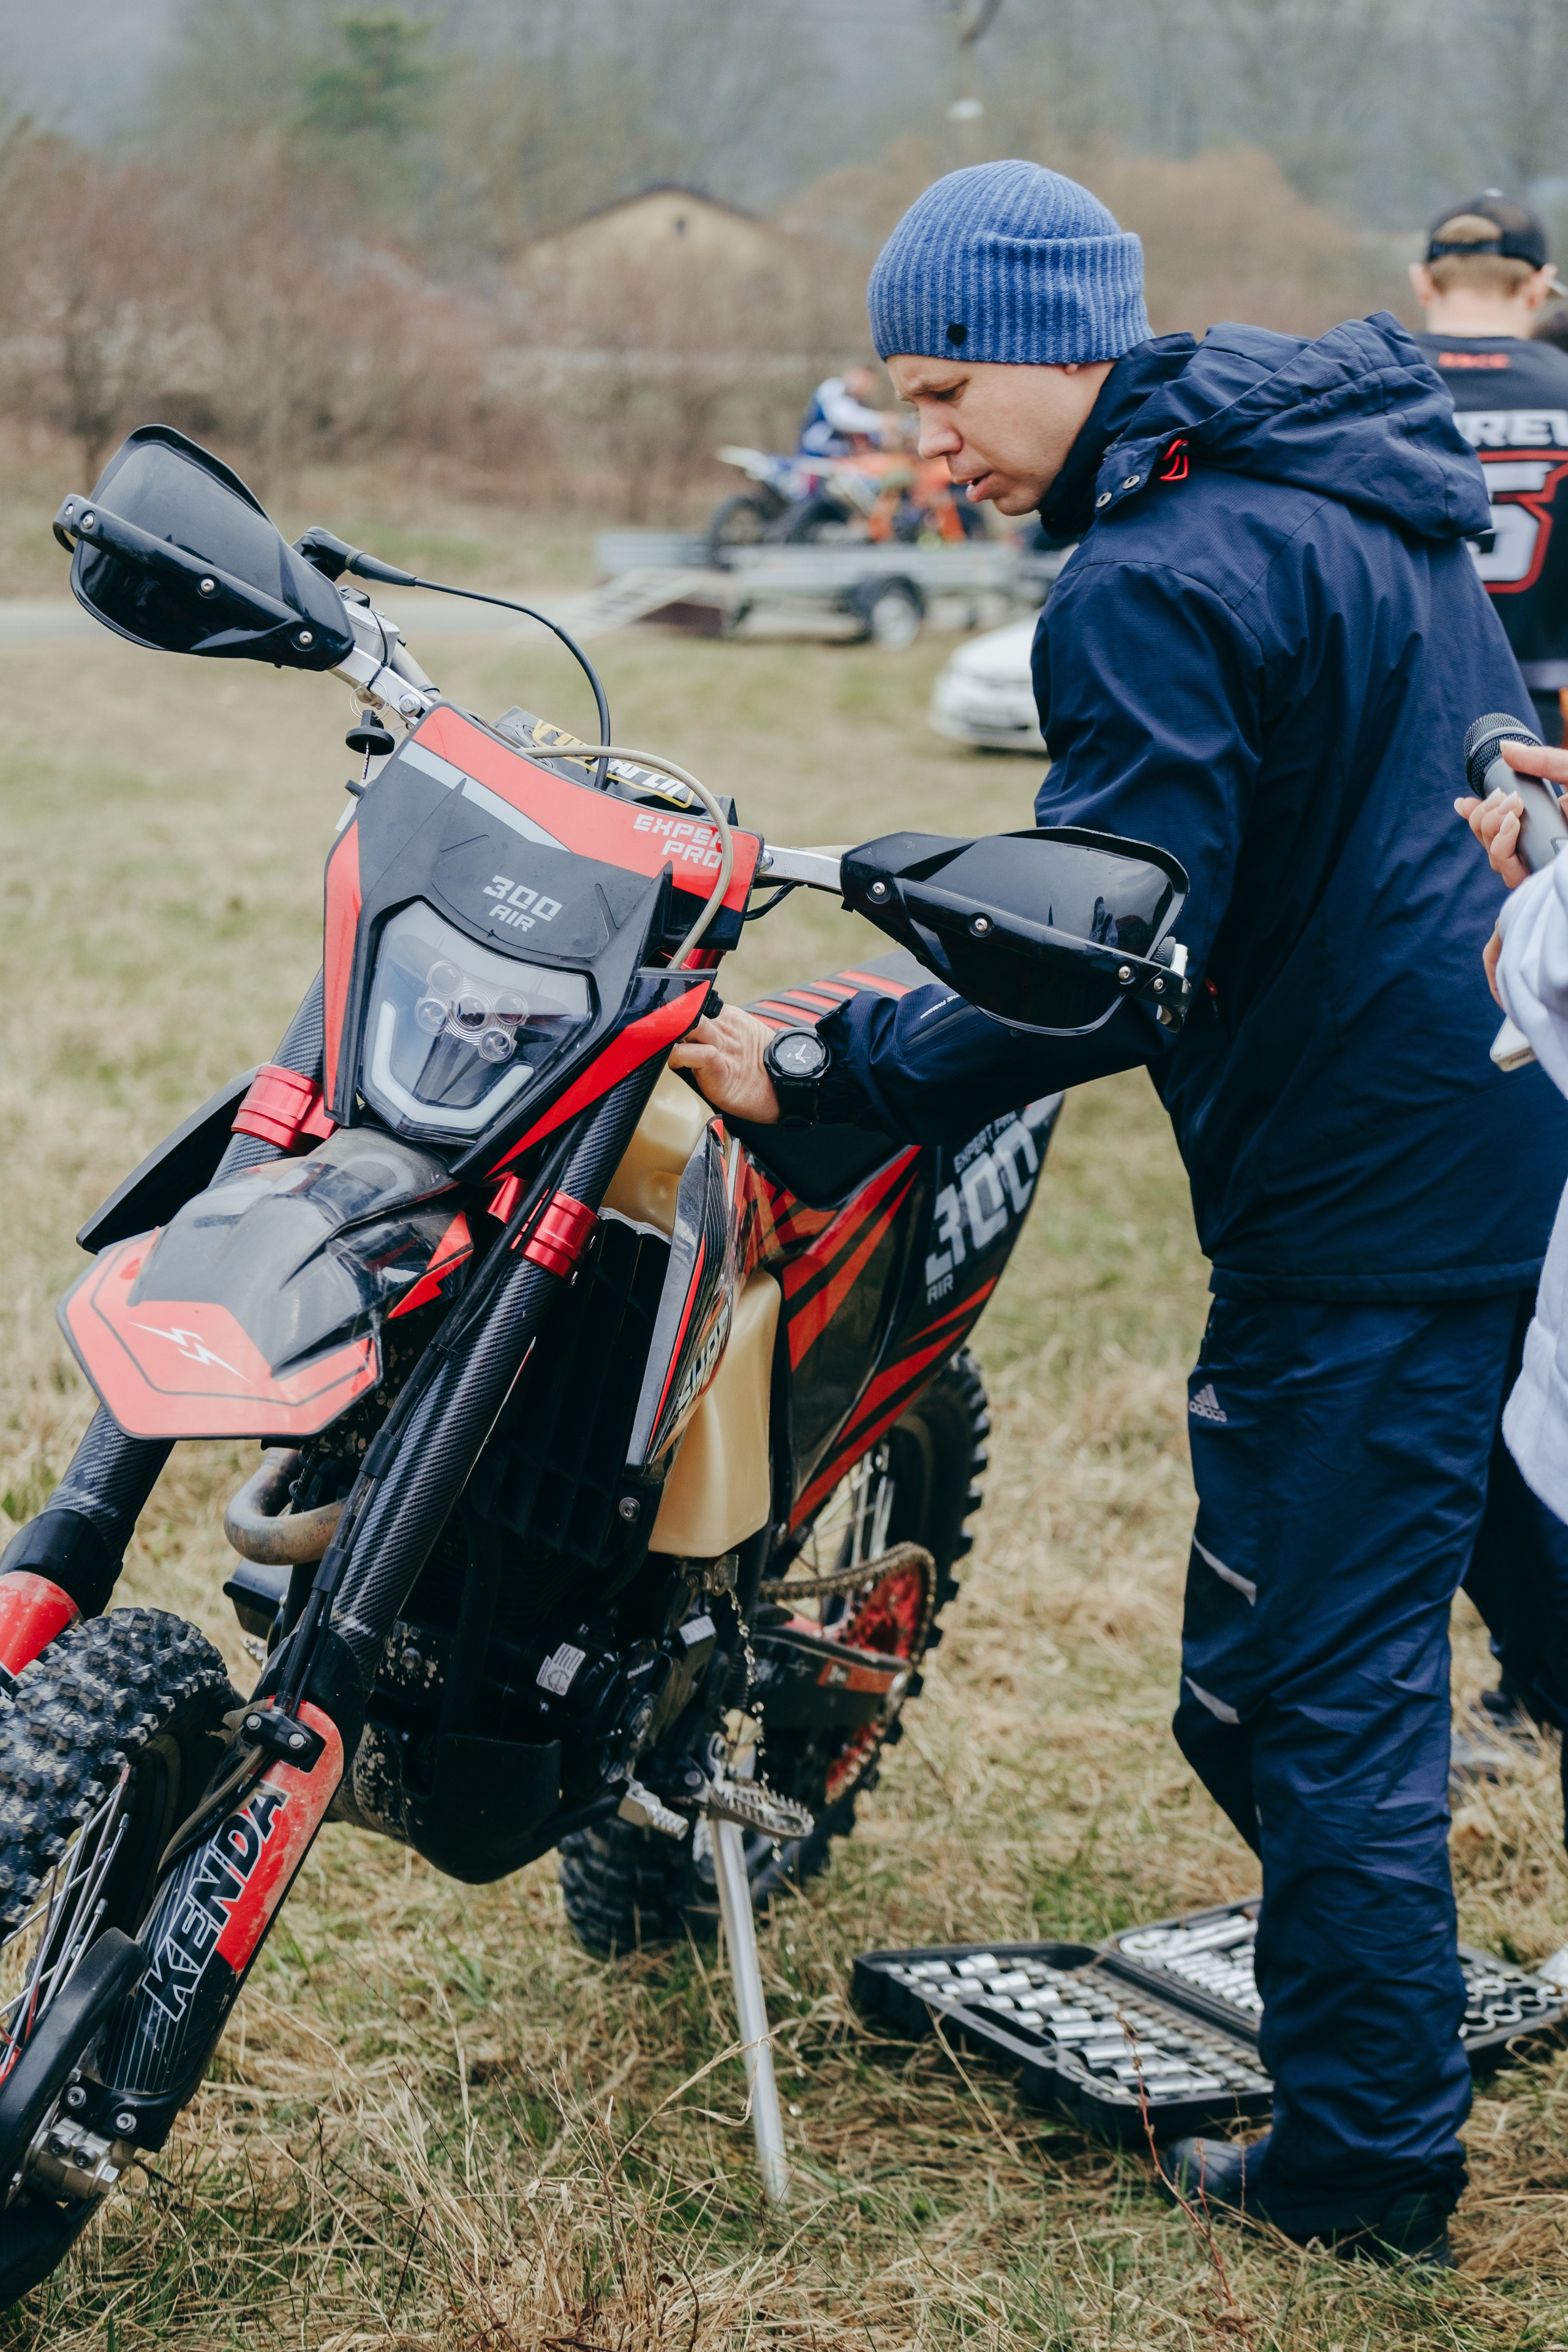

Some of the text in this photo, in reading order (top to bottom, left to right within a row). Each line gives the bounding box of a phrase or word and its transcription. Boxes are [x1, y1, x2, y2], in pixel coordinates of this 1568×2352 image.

[662, 840, 723, 869] PRO
[483, 875, 563, 922] 300
[489, 904, 536, 932] AIR
[925, 1119, 1039, 1286] 300
[927, 1272, 954, 1305] AIR
[141, 1779, 292, 2022] KENDA
